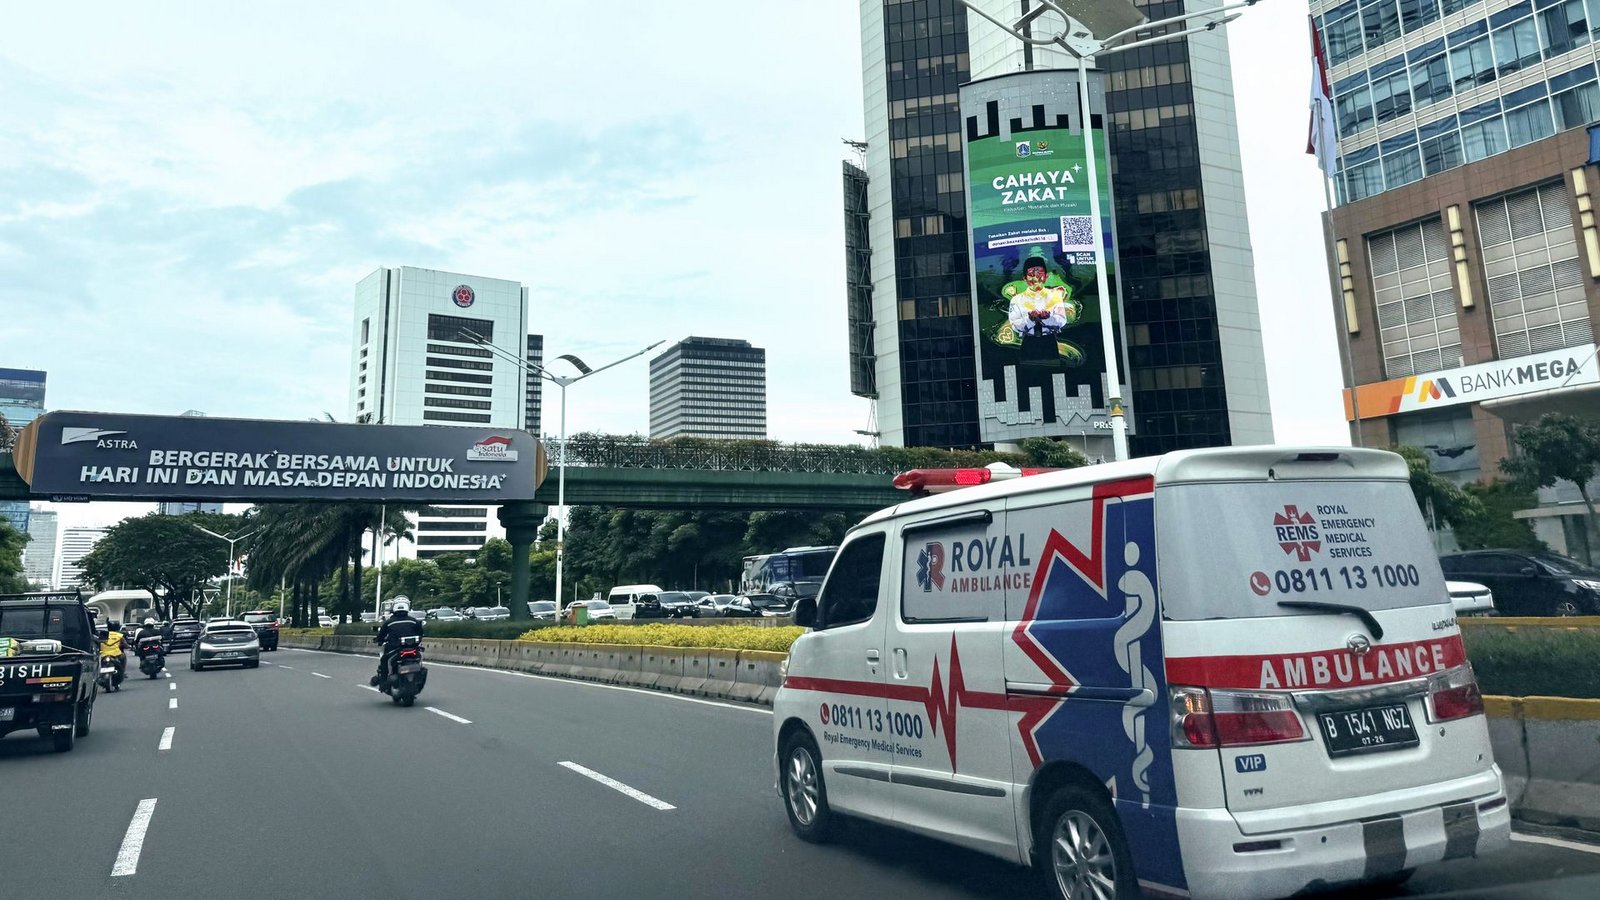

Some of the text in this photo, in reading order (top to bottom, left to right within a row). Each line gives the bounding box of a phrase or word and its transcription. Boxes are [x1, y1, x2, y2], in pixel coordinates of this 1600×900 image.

[992, 170, 1075, 190] CAHAYA
[1001, 186, 1068, 205] ZAKAT
[96, 439, 138, 449] ASTRA
[149, 449, 454, 473] BERGERAK BERSAMA UNTUK
[80, 465, 502, 489] HARI INI DAN MASA DEPAN INDONESIA
[1317, 504, 1348, 515] ROYAL
[1275, 525, 1319, 541] REMS
[1321, 518, 1375, 529] EMERGENCY
[1325, 532, 1367, 544] MEDICAL
[951, 533, 1031, 572] ROYAL
[1330, 547, 1372, 559] SERVICES
[951, 572, 1031, 593] AMBULANCE
[1274, 564, 1420, 594] 0811 13 1000
[1260, 644, 1446, 689] AMBULANCE
[832, 703, 923, 739] 0811 13 1000
[1325, 707, 1410, 738] B 1541 NGZ
[824, 731, 922, 758] Royal Emergency Medical Services
[1361, 735, 1385, 745] 07-26
[1239, 756, 1263, 770] VIP
